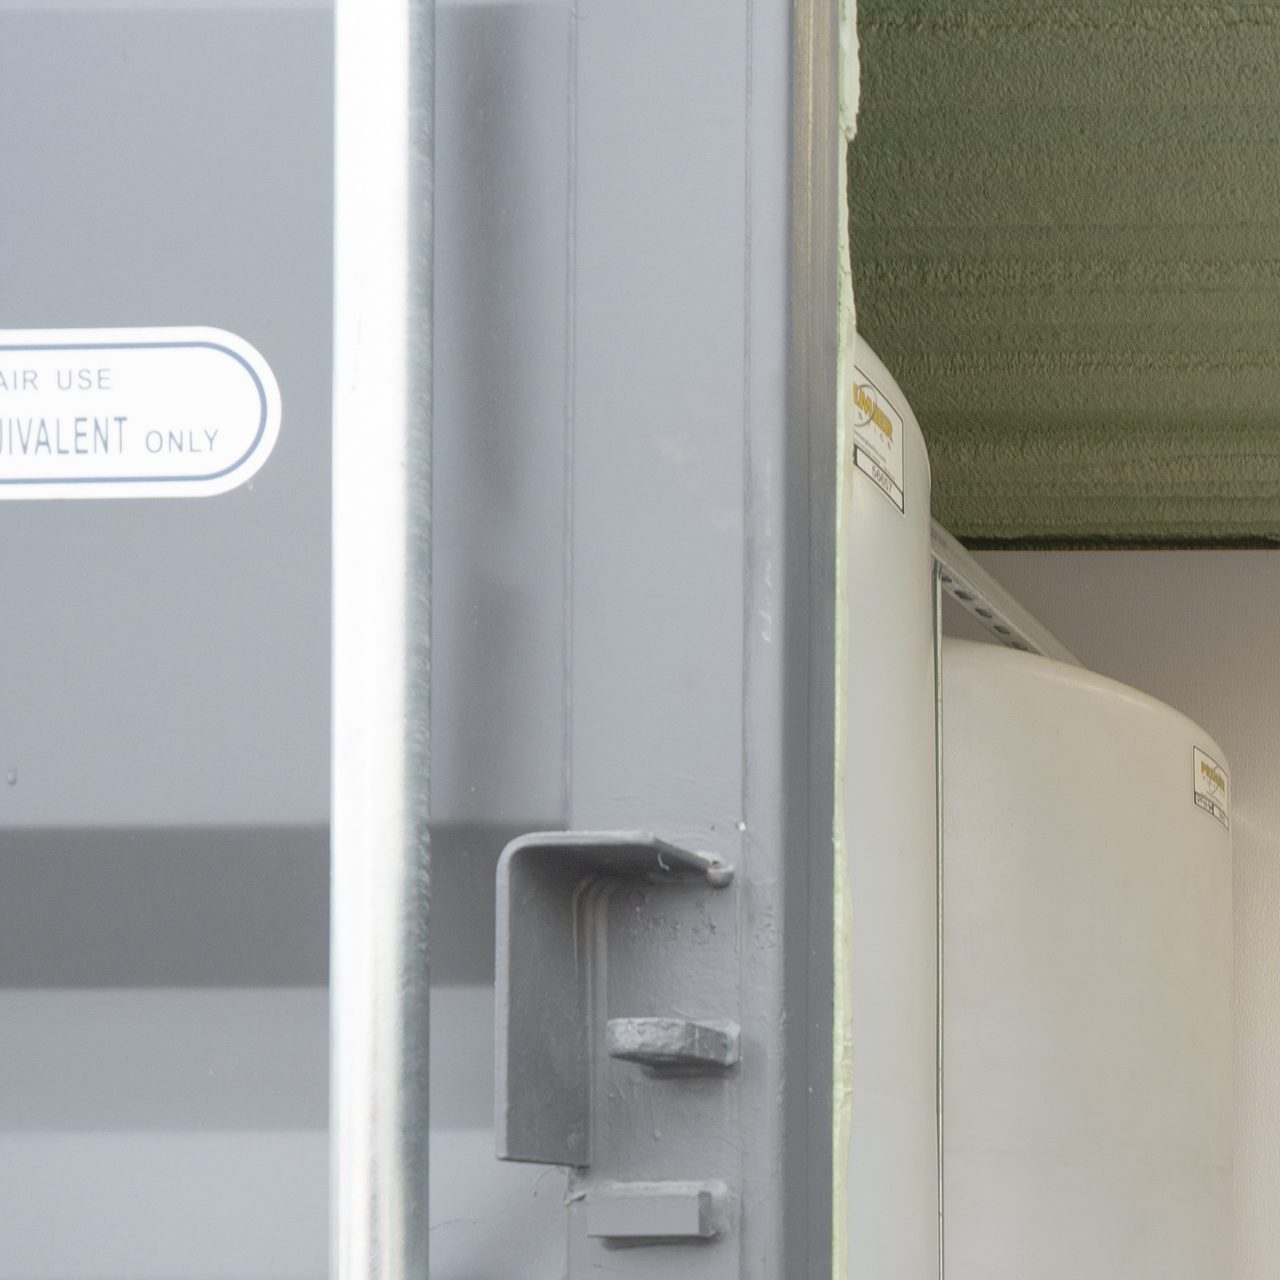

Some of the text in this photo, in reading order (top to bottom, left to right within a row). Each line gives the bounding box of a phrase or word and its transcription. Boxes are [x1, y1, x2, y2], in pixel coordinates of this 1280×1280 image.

[57, 368, 112, 391] USE
[0, 416, 219, 455] IVALENT ONLY
